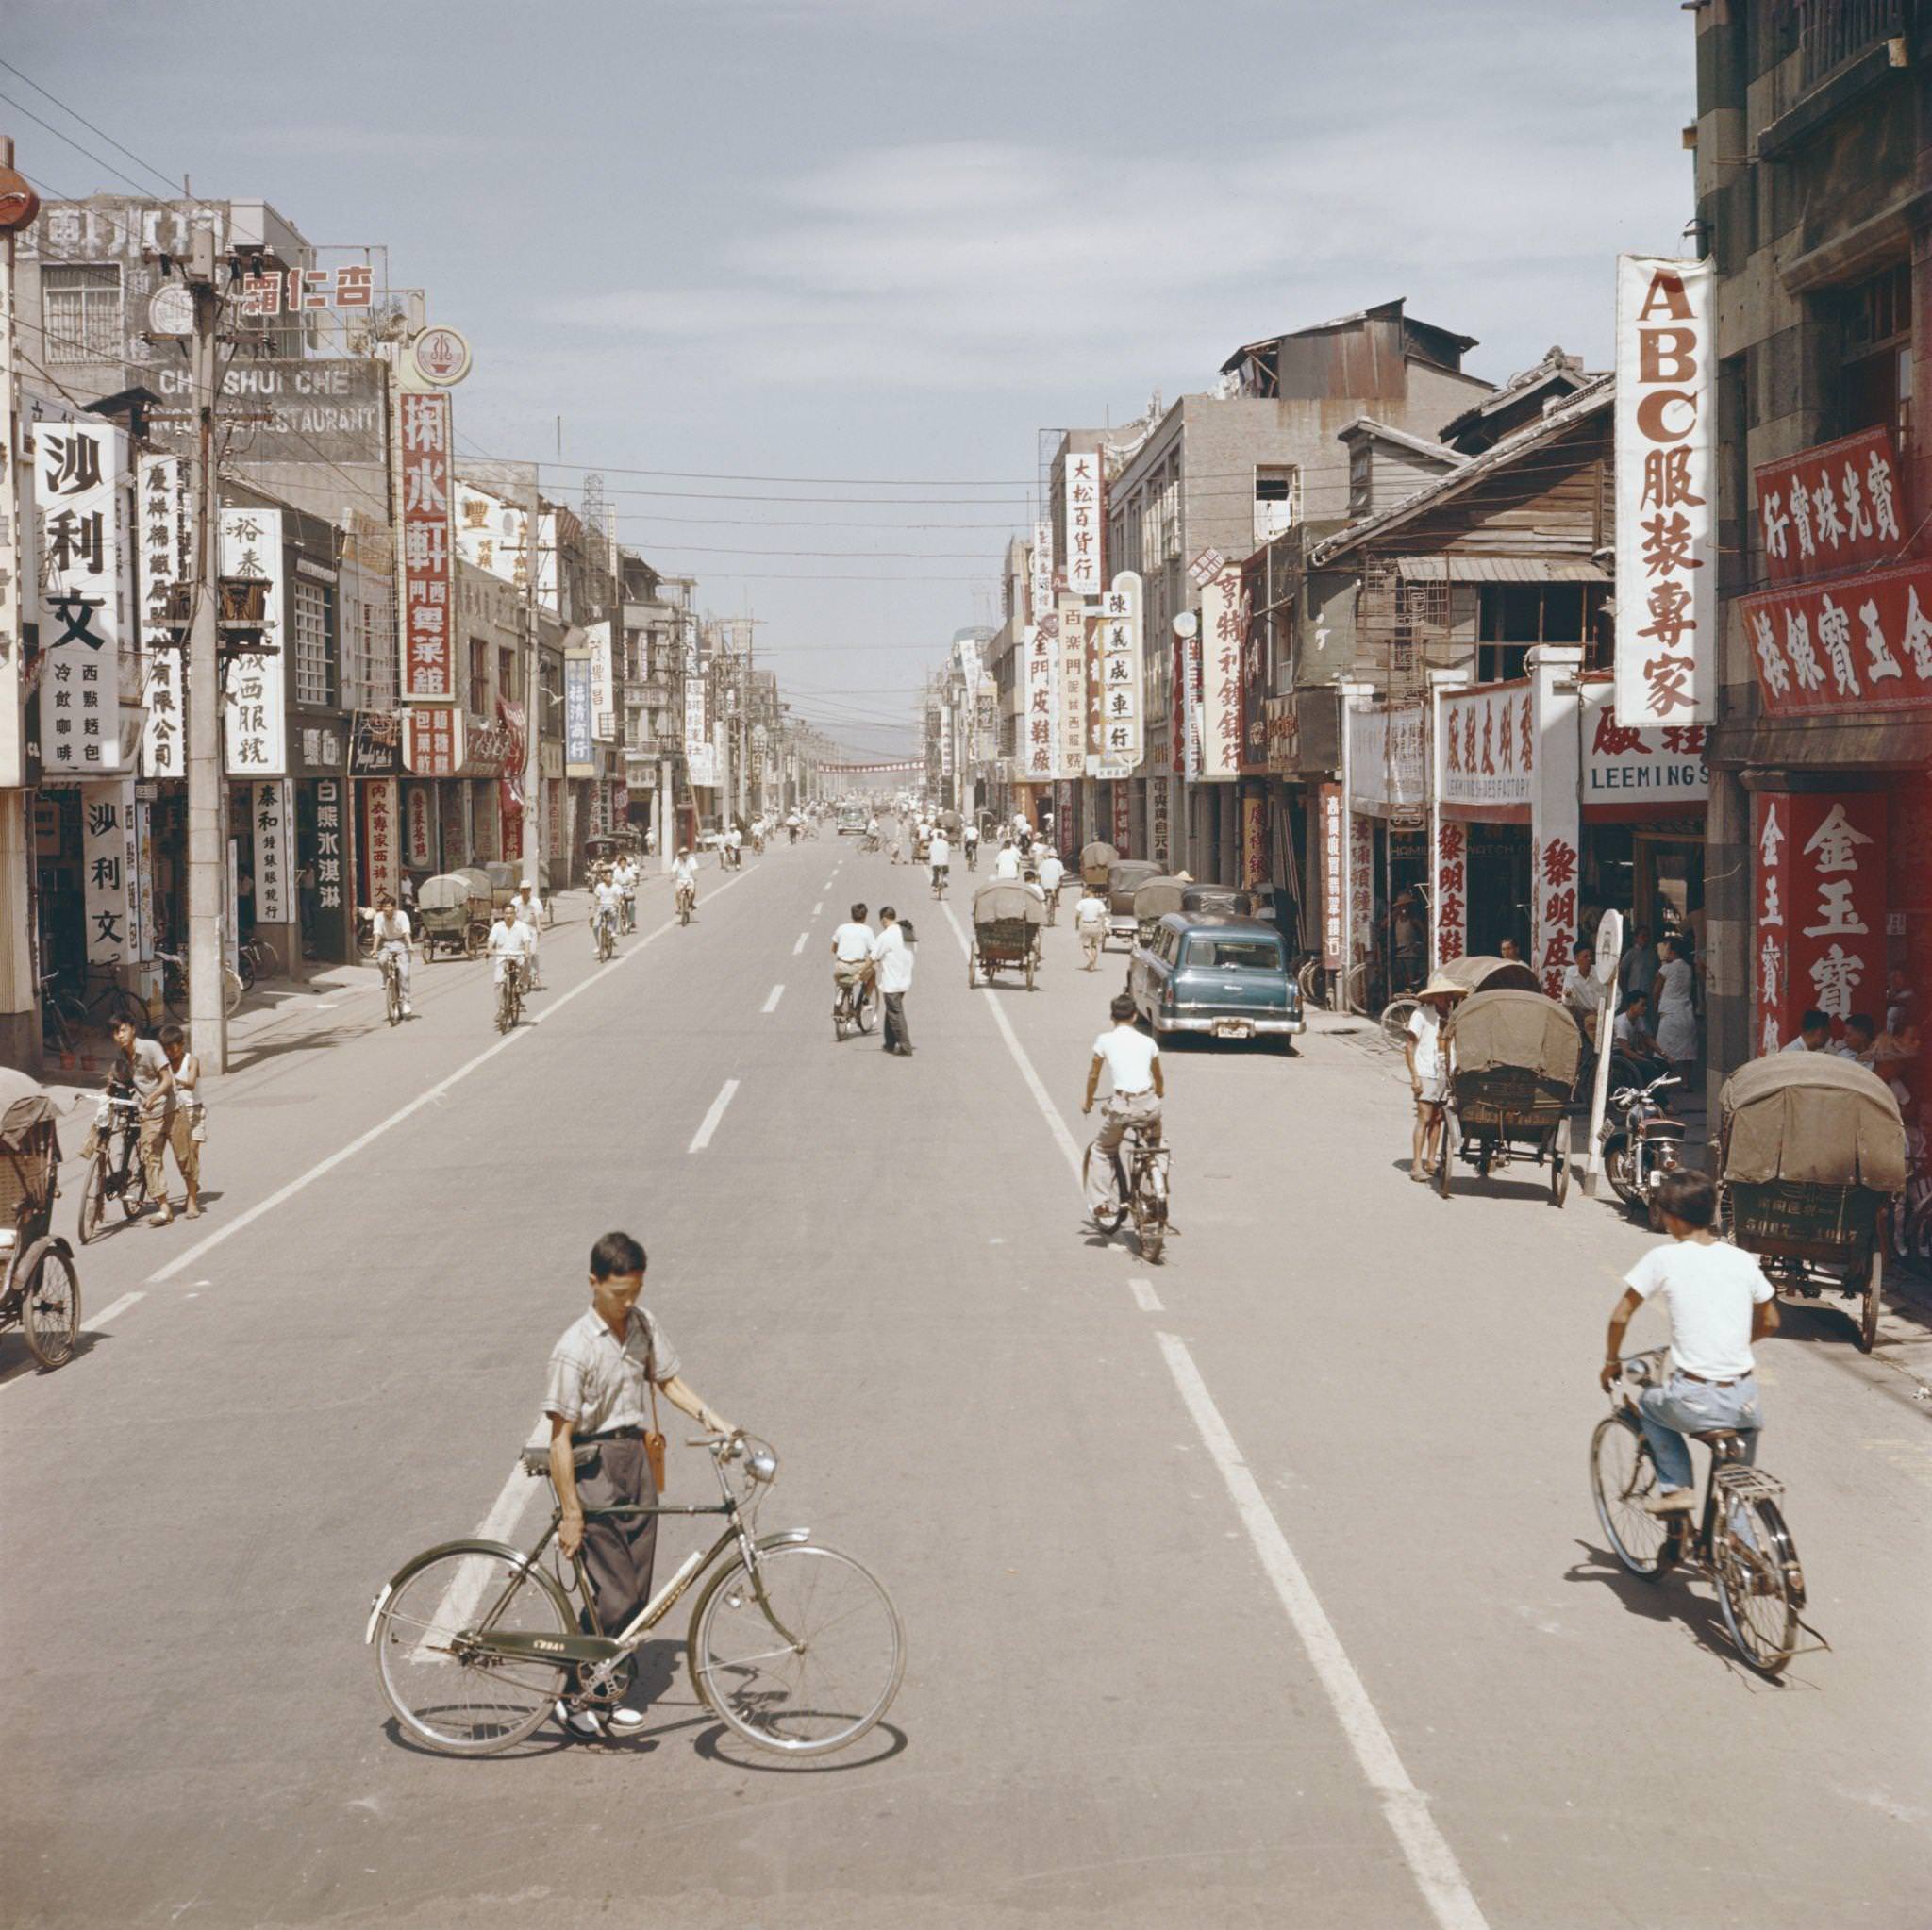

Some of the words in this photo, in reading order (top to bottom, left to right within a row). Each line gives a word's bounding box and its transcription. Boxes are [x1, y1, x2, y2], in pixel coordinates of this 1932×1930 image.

[43, 432, 107, 651] 沙利文
[1073, 458, 1092, 580] 大松百貨行
[1108, 595, 1129, 749] 陳義成車行
[88, 802, 124, 944] 沙利文
[317, 778, 341, 908] 白熊冰淇淋
